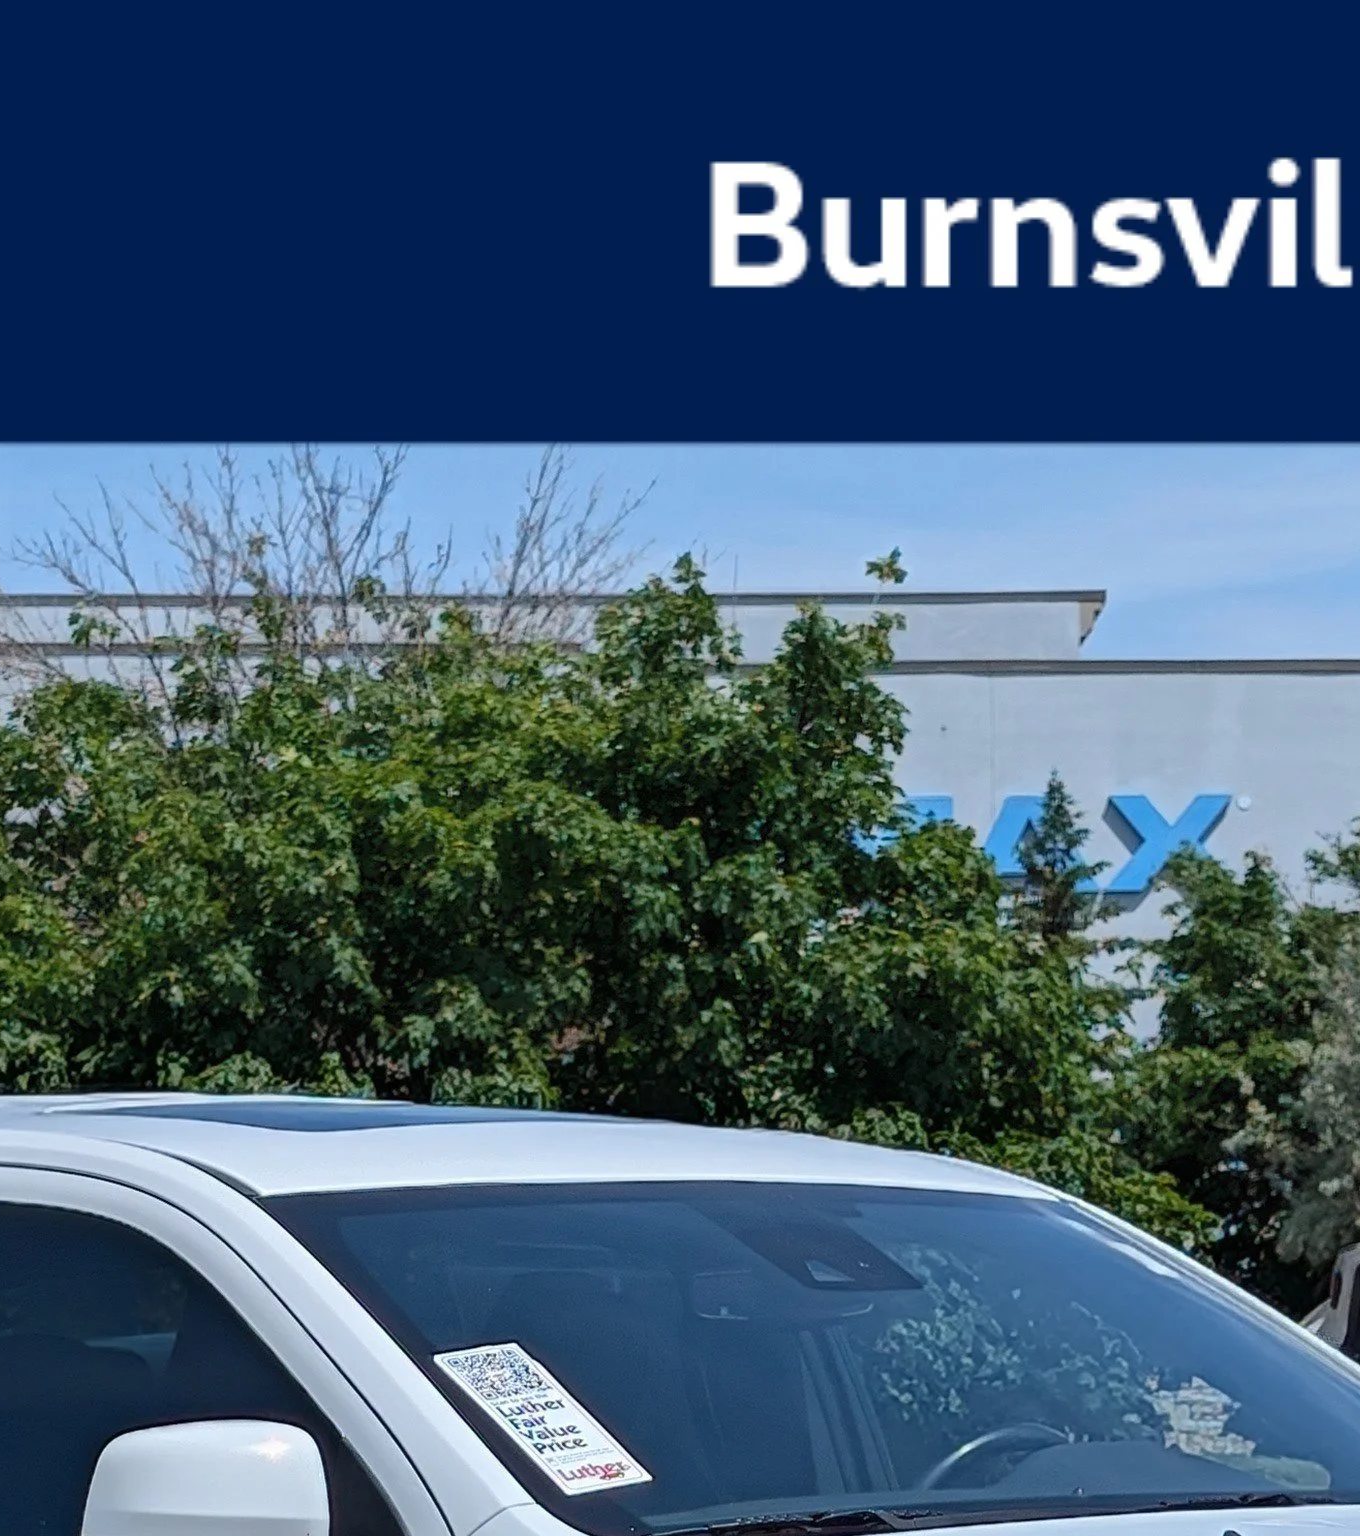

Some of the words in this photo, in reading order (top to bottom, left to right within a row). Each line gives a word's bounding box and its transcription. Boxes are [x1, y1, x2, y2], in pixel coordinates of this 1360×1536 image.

[496, 1398, 565, 1417] Luther
[509, 1415, 547, 1430] Fair
[518, 1424, 581, 1441] Value
[532, 1438, 588, 1454] Price
[557, 1461, 627, 1481] Luther
